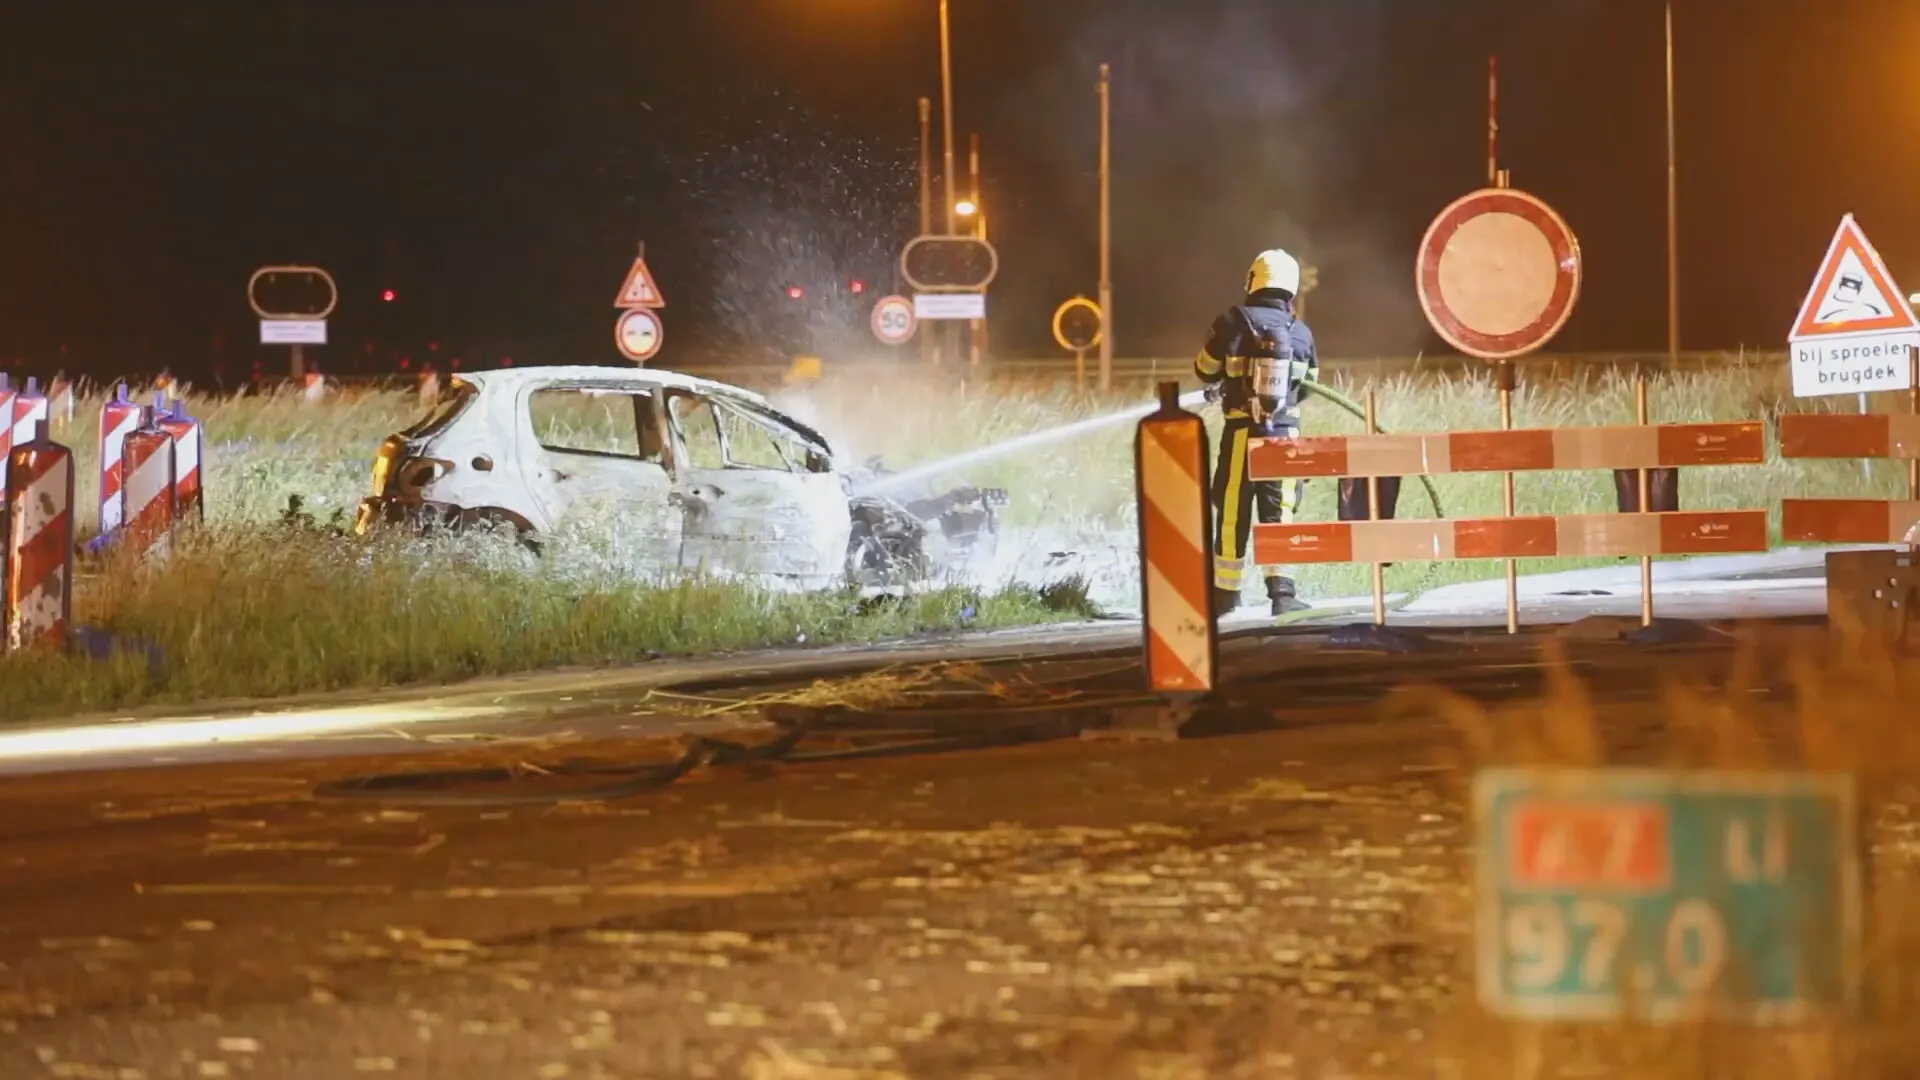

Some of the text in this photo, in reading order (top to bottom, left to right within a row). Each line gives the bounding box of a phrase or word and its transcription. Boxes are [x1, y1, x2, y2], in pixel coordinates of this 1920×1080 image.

[882, 312, 909, 329] 50
[1799, 347, 1823, 364] bij
[1818, 364, 1896, 384] brugdek
[1505, 899, 1730, 994] 97.0
